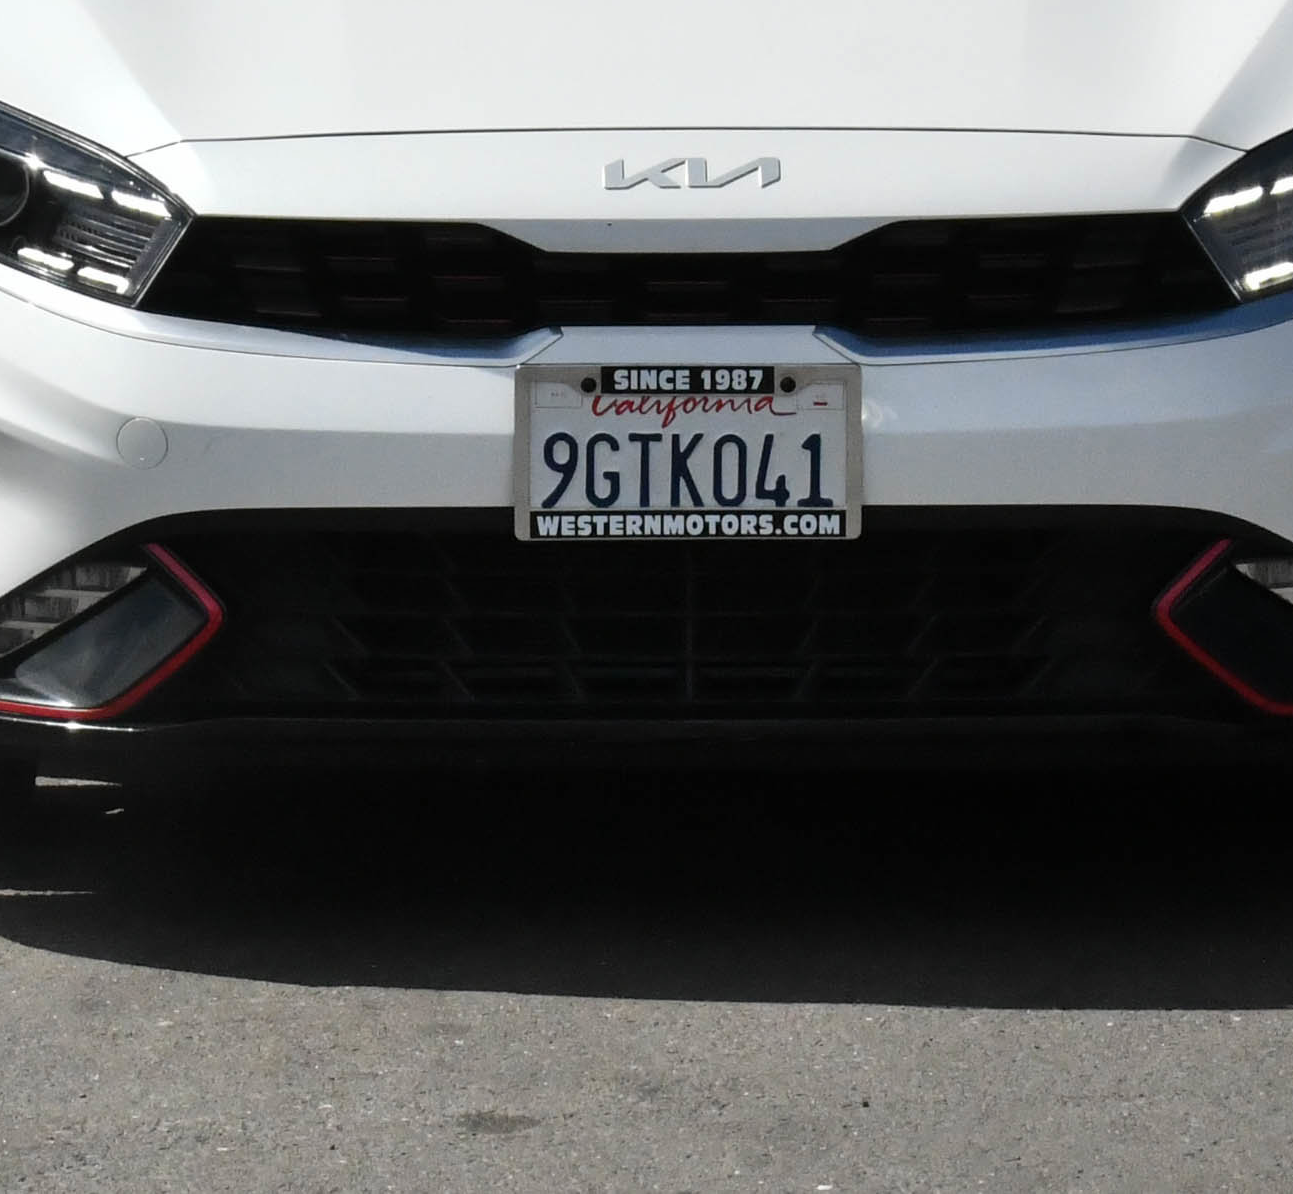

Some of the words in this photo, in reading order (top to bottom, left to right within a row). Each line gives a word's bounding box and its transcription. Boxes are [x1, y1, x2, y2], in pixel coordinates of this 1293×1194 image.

[613, 368, 691, 392] SINCE
[700, 368, 765, 392] 1987
[541, 431, 834, 509] 9GTK041
[535, 513, 842, 538] WESTERNMOTORS.COM
